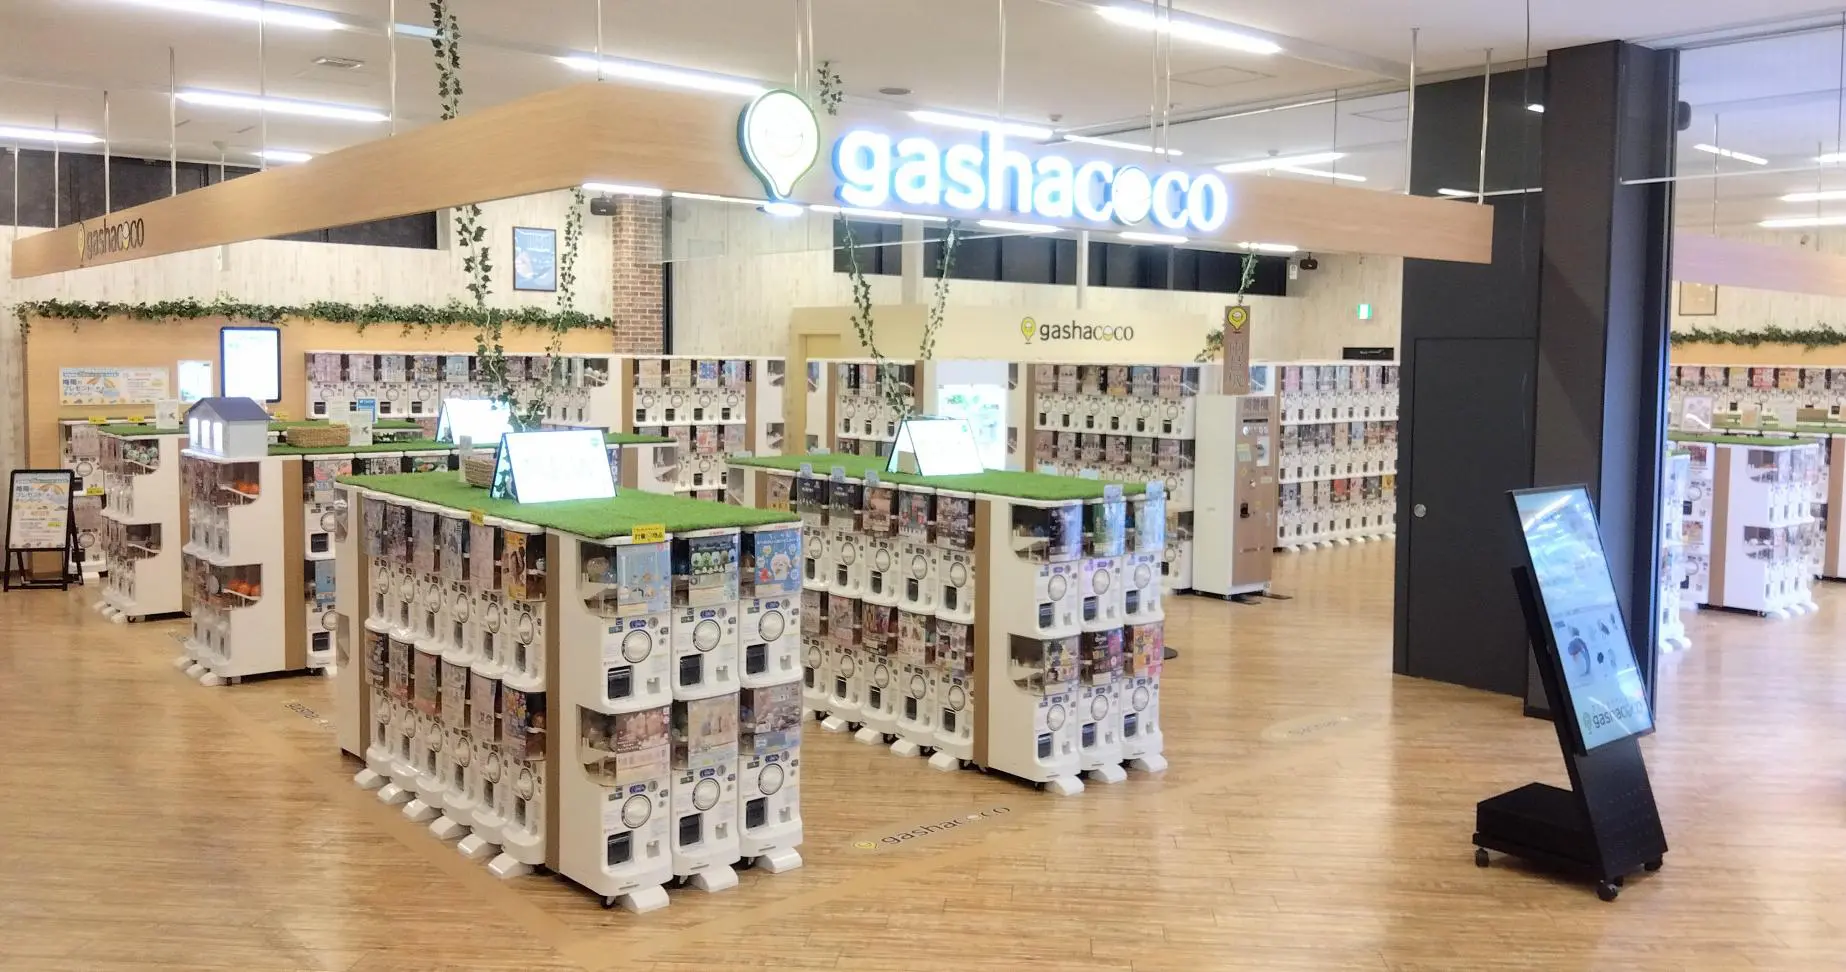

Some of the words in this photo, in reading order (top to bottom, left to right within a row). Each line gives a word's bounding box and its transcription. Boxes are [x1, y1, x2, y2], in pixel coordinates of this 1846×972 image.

[833, 127, 1229, 232] gashacoco
[86, 217, 145, 260] gashacoco
[1038, 321, 1135, 343] gashacoco
[880, 806, 1010, 845] gashacoco
